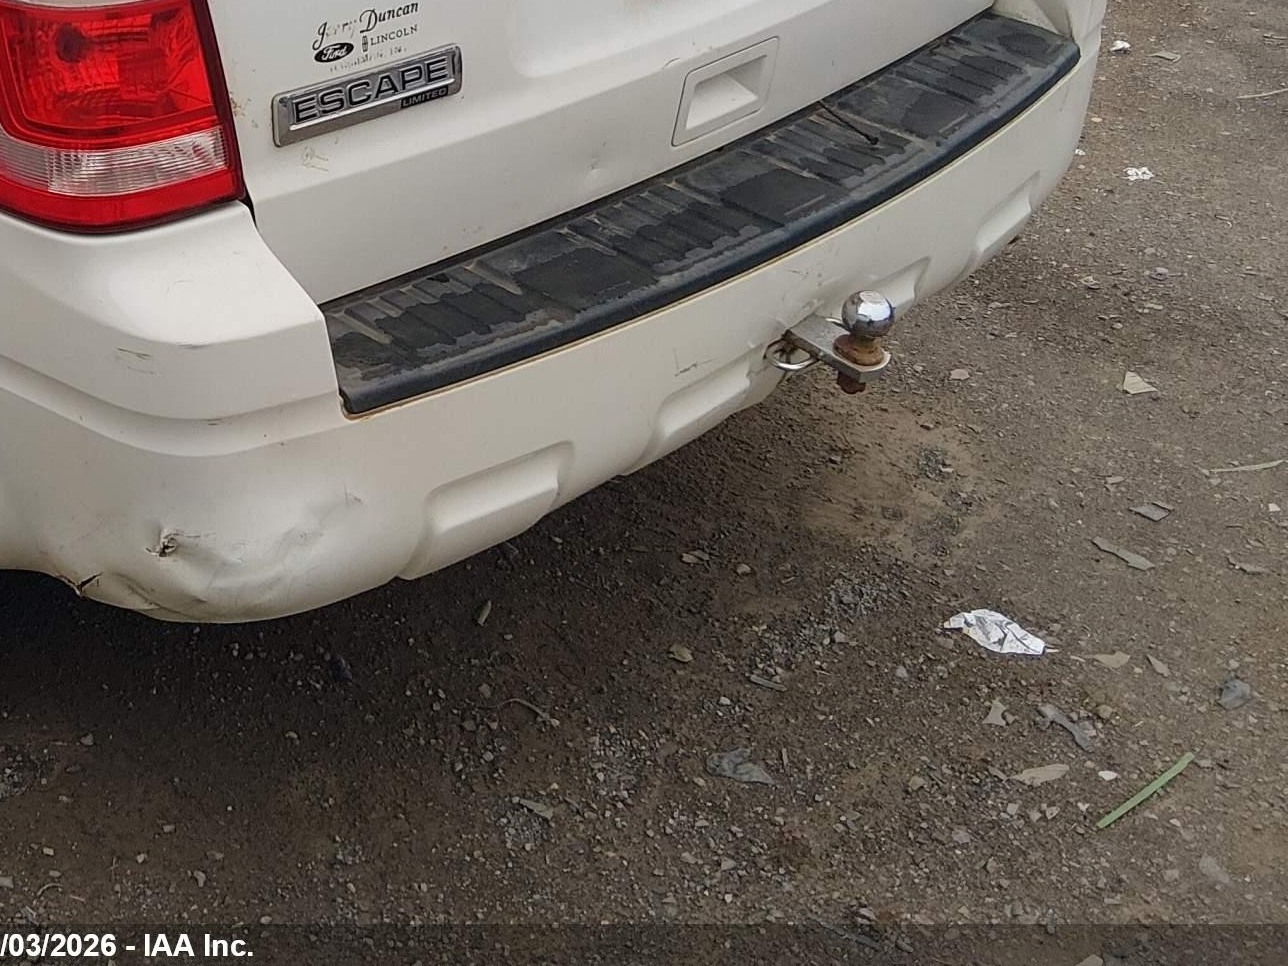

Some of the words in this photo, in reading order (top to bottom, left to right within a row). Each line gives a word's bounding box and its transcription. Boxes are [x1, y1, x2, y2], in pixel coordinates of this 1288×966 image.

[360, 1, 419, 34] Duncan
[370, 24, 418, 46] LINCOLN
[320, 44, 349, 61] Ford
[293, 55, 449, 124] ESCAPE
[401, 87, 448, 108] LIMITED
